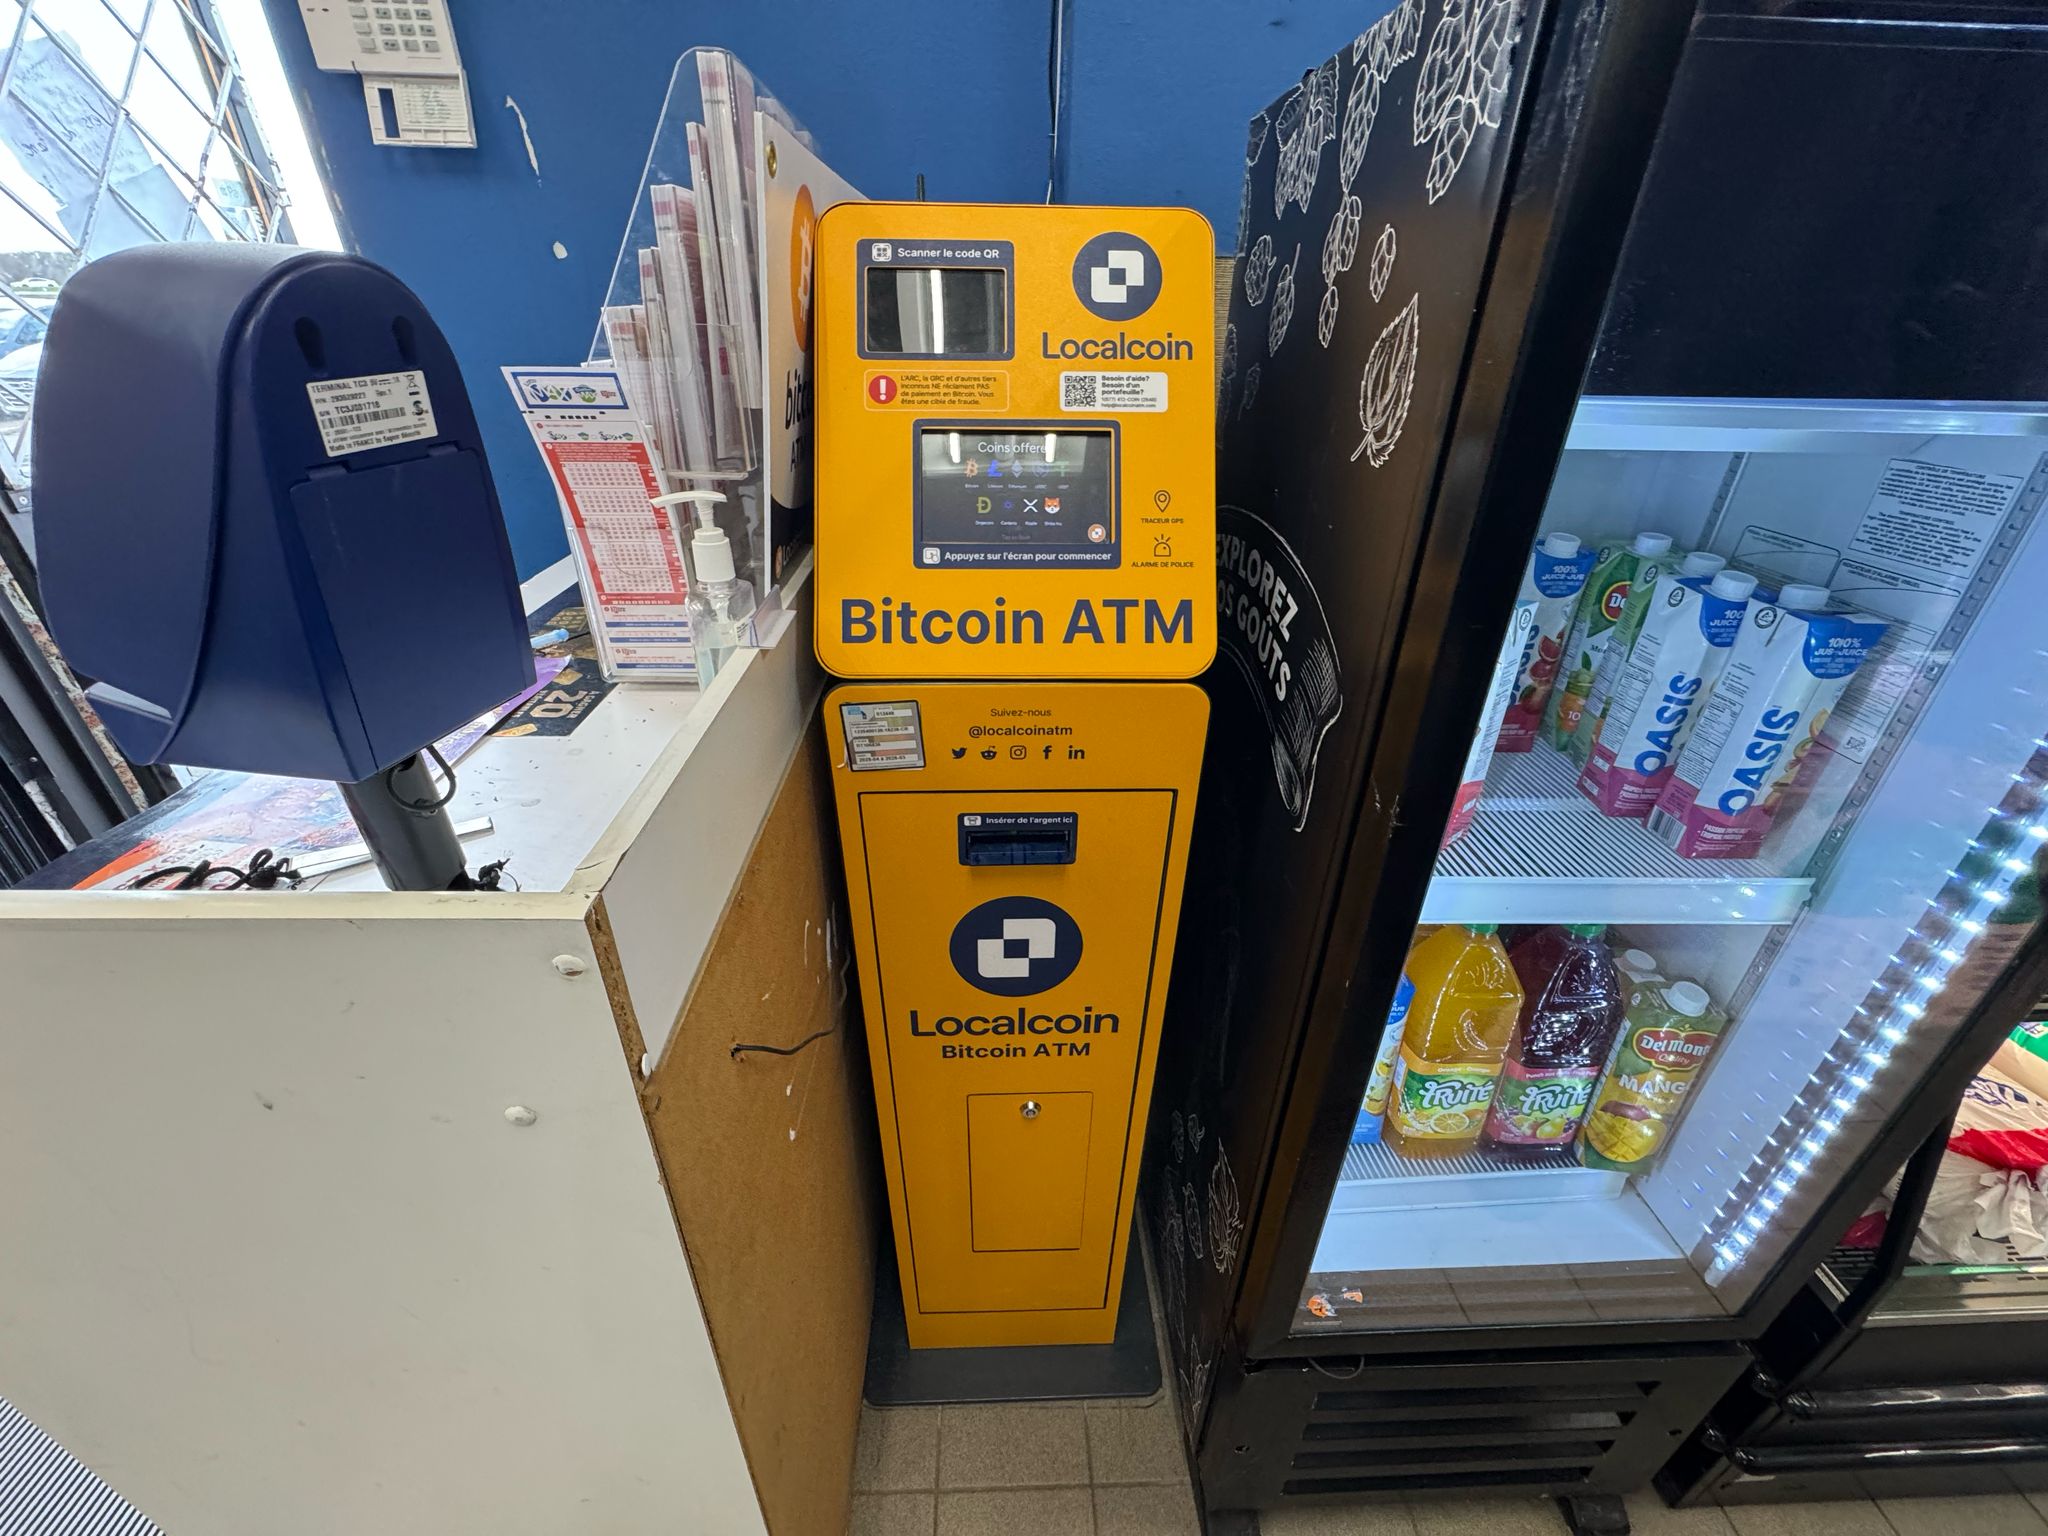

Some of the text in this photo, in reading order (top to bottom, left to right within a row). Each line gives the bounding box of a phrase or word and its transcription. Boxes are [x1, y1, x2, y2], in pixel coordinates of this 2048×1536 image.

[897, 248, 1000, 259] Scanner le code QR
[1042, 332, 1193, 361] Localcoin
[978, 442, 1010, 453] Coins
[944, 552, 984, 561] Appuyez
[1003, 552, 1033, 561] l'écran
[1058, 553, 1111, 561] commencer
[1553, 565, 1578, 573] 100%
[842, 596, 1193, 644] Bitcoin ATM
[1724, 609, 1744, 619] 100
[1217, 579, 1292, 701] OS GOÛTS
[1828, 637, 1863, 648] 100%
[1814, 648, 1869, 656] JUS-JUICE
[990, 708, 1052, 717] Suivez-nous
[1634, 672, 1703, 777] OASIS
[969, 725, 1072, 738] @localcoinatm
[1718, 706, 1801, 817] OASIS
[910, 1006, 1119, 1037] Localcoin
[942, 1043, 1090, 1059] Bitcoin ATM
[1640, 1035, 1713, 1057] Del Mont
